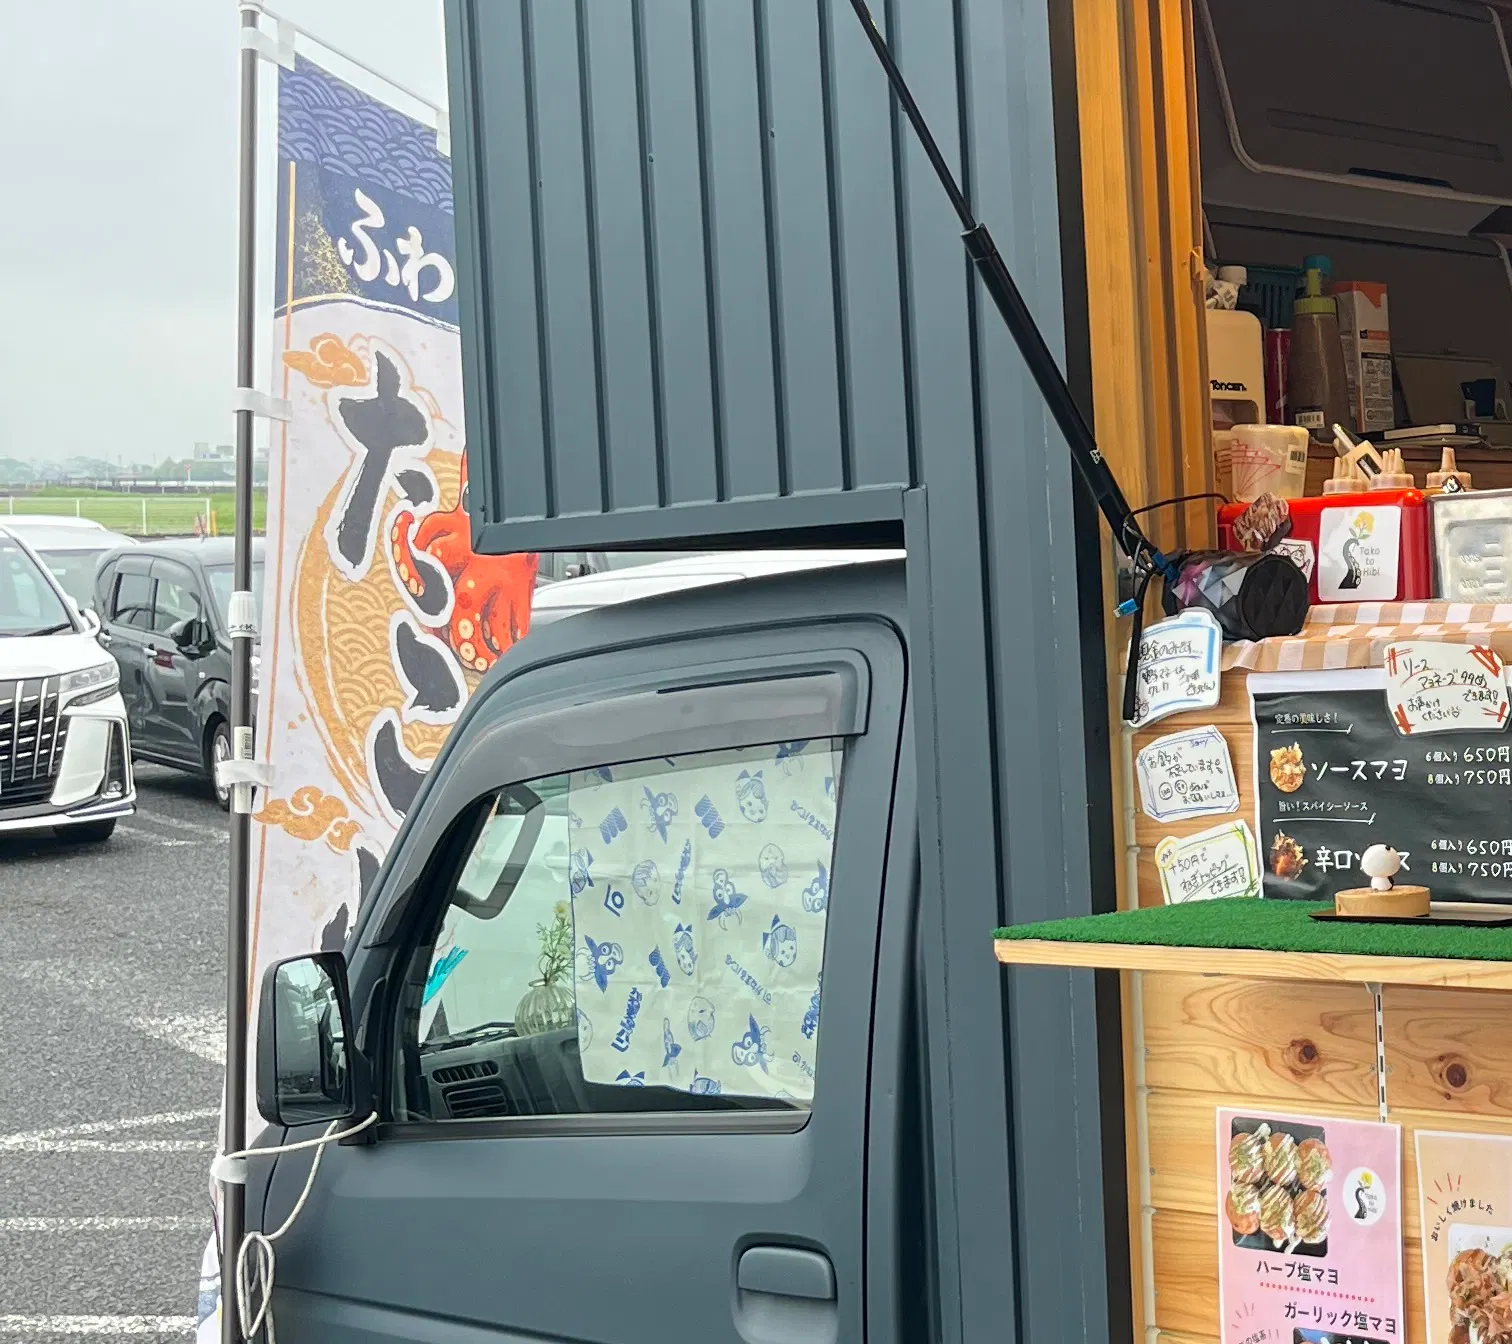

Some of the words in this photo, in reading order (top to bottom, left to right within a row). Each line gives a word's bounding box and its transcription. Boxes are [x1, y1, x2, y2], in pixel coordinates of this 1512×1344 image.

[338, 188, 455, 303] ふわ
[1359, 547, 1380, 556] Tako
[1366, 557, 1374, 565] to
[1363, 568, 1380, 576] Hibi
[1425, 750, 1458, 762] 6個入り
[1463, 746, 1510, 764] 650円
[1311, 760, 1408, 781] ソースマヨ
[1427, 773, 1460, 785] 8個入り
[1463, 768, 1511, 785] 750円
[1431, 840, 1462, 851] 6個入り
[1432, 862, 1463, 874] 8個入り
[1431, 1198, 1494, 1241] おいしく焼けました
[1256, 1260, 1338, 1284] ハーブ塩マヨ
[1284, 1301, 1396, 1334] ガーリック塩マヨ
